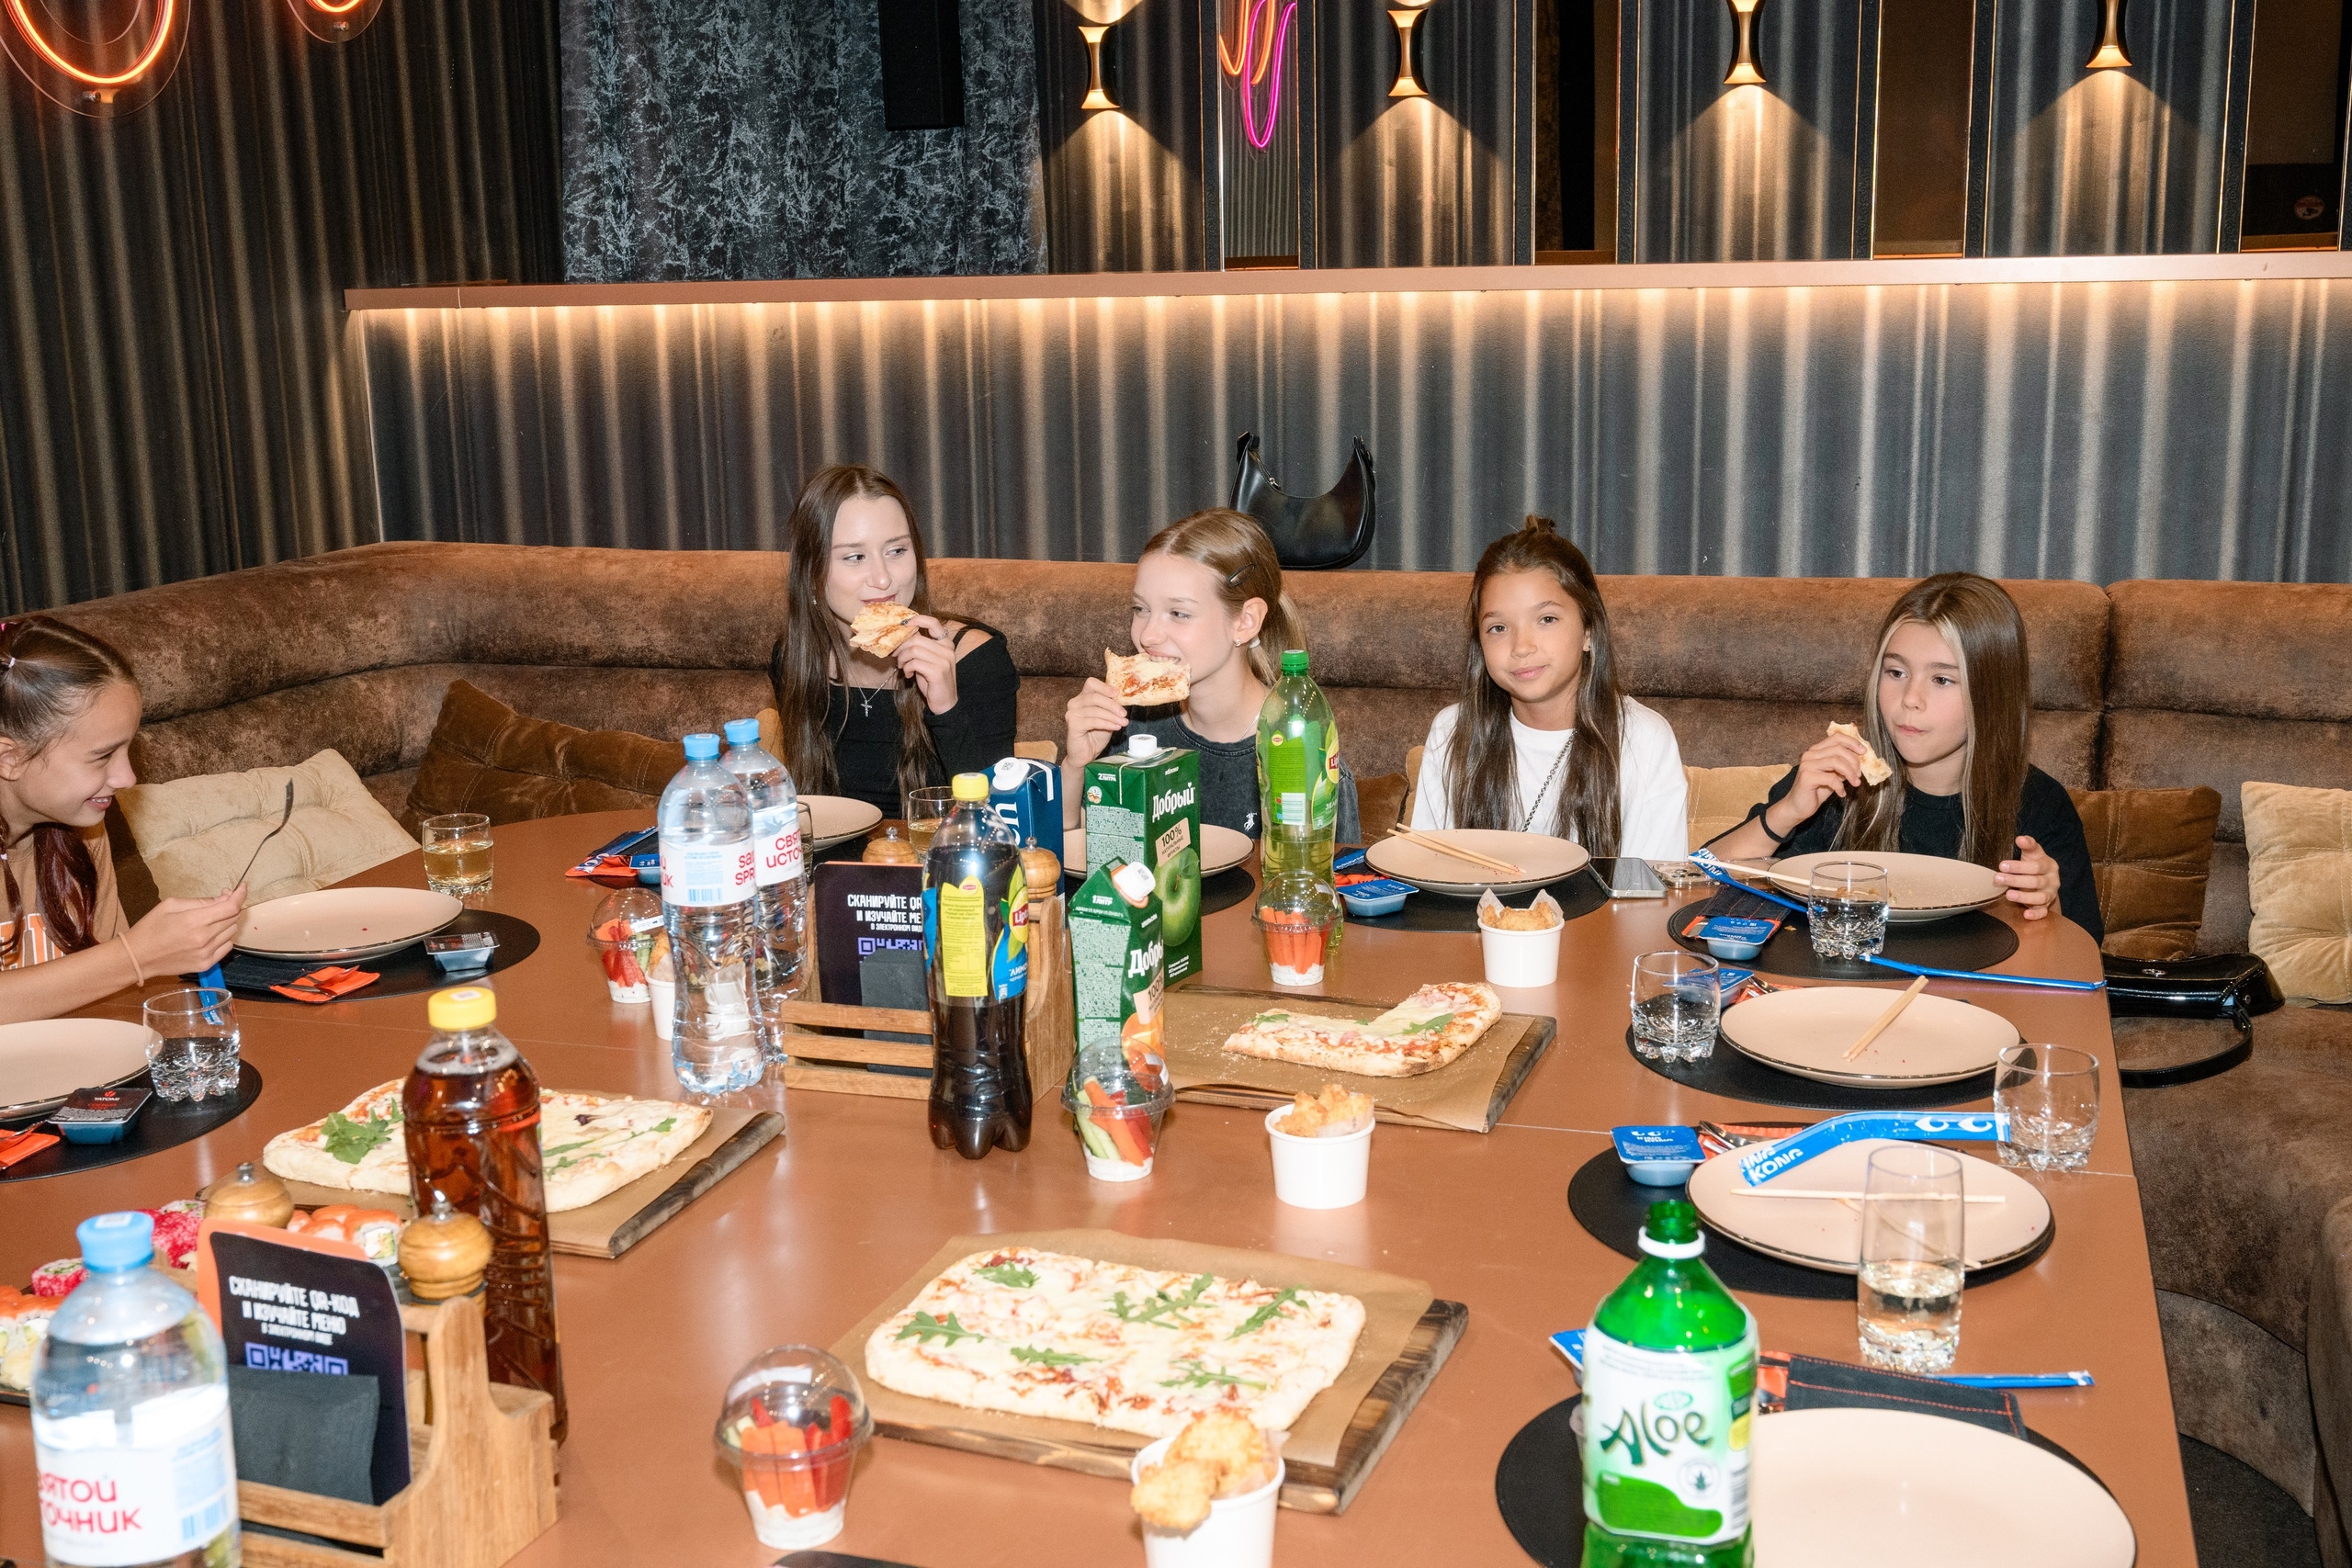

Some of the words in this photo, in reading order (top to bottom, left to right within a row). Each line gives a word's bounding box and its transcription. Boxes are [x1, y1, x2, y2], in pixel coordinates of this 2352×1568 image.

[1152, 783, 1195, 823] Добрый
[1161, 824, 1182, 847] 100%
[736, 867, 754, 886] SPR
[847, 894, 907, 909] СКАНИРУЙТЕ
[910, 897, 922, 910] QR
[856, 910, 863, 921] И
[865, 910, 907, 923] ИЗУЧАЙТЕ
[909, 912, 922, 924] МЕ
[1748, 1148, 1804, 1182] KONG
[1600, 1401, 1714, 1466] Aloe
